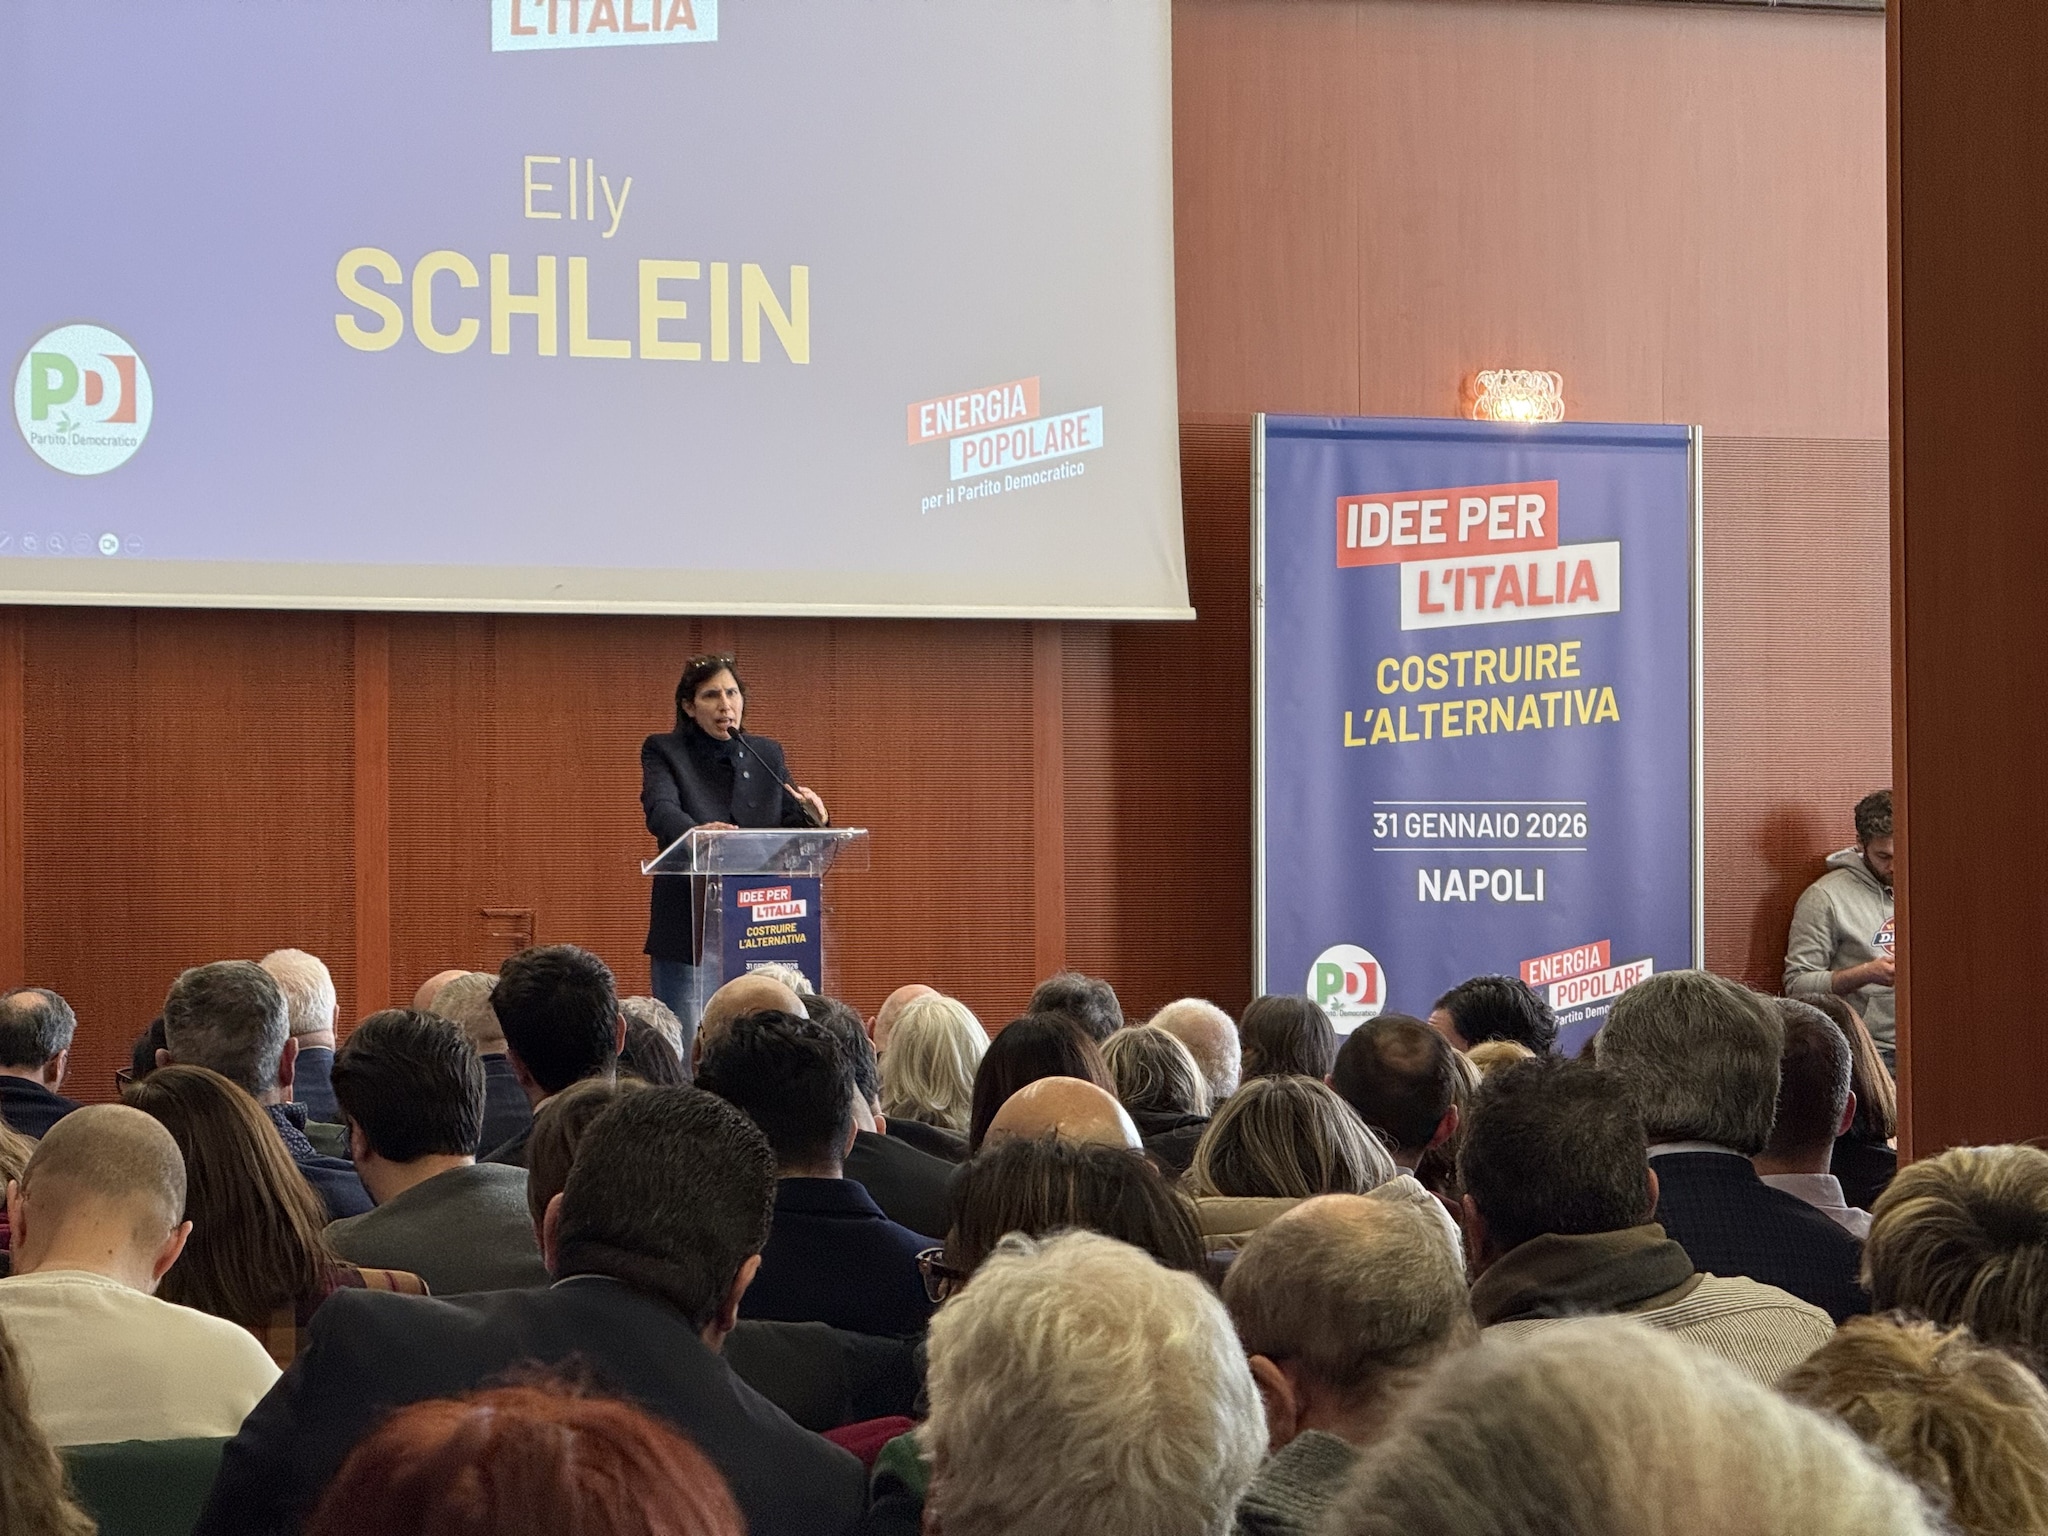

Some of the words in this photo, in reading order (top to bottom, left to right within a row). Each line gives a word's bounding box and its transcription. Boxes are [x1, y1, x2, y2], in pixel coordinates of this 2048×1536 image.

[524, 155, 632, 238] Elly
[335, 247, 809, 364] SCHLEIN
[920, 384, 1027, 438] ENERGIA
[30, 432, 66, 446] Partito
[72, 433, 137, 447] Democratico
[962, 414, 1091, 473] POPOLARE
[921, 494, 943, 514] per
[946, 488, 955, 505] il
[958, 480, 1000, 502] Partito
[1005, 461, 1085, 491] Democratico
[1346, 499, 1448, 549] IDEE
[1458, 493, 1546, 542] PER
[1418, 559, 1600, 615] L'ITALIA
[1376, 641, 1582, 695] COSTRUIRE
[1343, 686, 1620, 747] L'ALTERNATIVA
[1373, 812, 1398, 838] 31
[1404, 812, 1520, 838] GENNAIO
[1526, 812, 1588, 838] 2026
[740, 890, 765, 903] IDEE
[766, 888, 788, 901] PER
[1418, 868, 1544, 901] NAPOLI
[746, 922, 797, 937] COSTRUIRE
[756, 904, 802, 918] L'ITALIA
[739, 933, 806, 949] L'ALTERNATIVA
[1529, 945, 1601, 985] ENERGIA
[1557, 964, 1645, 1007] POPOLARE
